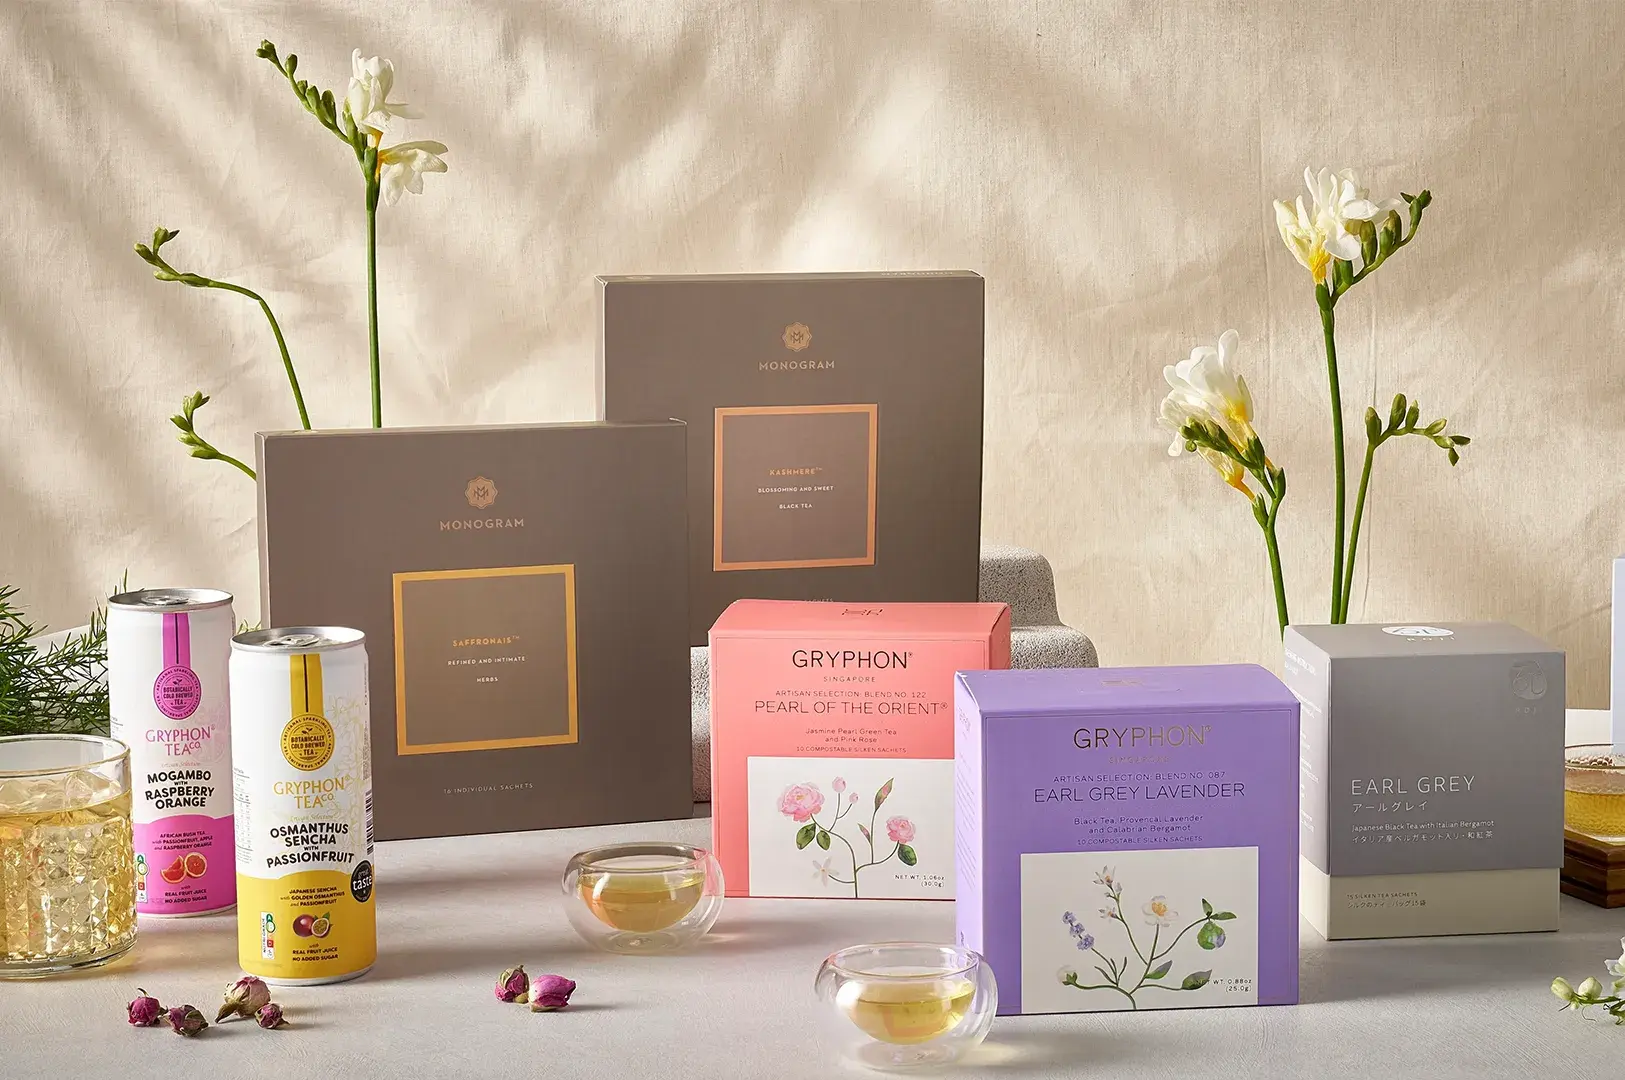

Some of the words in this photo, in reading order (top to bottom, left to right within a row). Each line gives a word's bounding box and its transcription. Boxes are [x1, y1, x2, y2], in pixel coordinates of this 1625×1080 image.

[759, 360, 835, 371] MONOGRAM
[440, 518, 524, 531] MONOGRAM
[755, 700, 809, 714] PEARL
[813, 701, 836, 714] OF
[841, 701, 873, 714] THE
[304, 741, 325, 749] BREWED
[303, 748, 315, 756] TEA
[147, 770, 212, 784] MOGAMBO
[1053, 775, 1094, 783] ARTISAN
[1155, 772, 1187, 780] BLEND
[454, 785, 497, 794] INDIVIDUAL
[500, 783, 534, 791] SACHETS
[1351, 778, 1408, 795] EARL
[1417, 775, 1476, 793] GREY
[145, 786, 215, 800] RASPBERRY
[1034, 788, 1084, 803] EARL
[1088, 786, 1140, 801] GREY
[1145, 782, 1245, 799] LAVENDER
[155, 797, 207, 809] ORANGE
[1352, 801, 1428, 813] アールグレイ
[1074, 817, 1098, 825] Black
[1164, 814, 1204, 822] Lavender
[270, 822, 349, 839] OSMANTHUS
[1106, 825, 1148, 833] Calabrian
[1150, 824, 1191, 834] Bergamot
[1352, 823, 1384, 832] Japanese
[1406, 822, 1418, 830] Tea
[1435, 821, 1459, 829] Italian
[1460, 820, 1494, 829] Bergamot
[285, 834, 337, 848] SENCHA
[266, 852, 355, 868] PASSIONFRUIT
[352, 875, 372, 891] taste
[314, 891, 345, 900] OSMANTHUS
